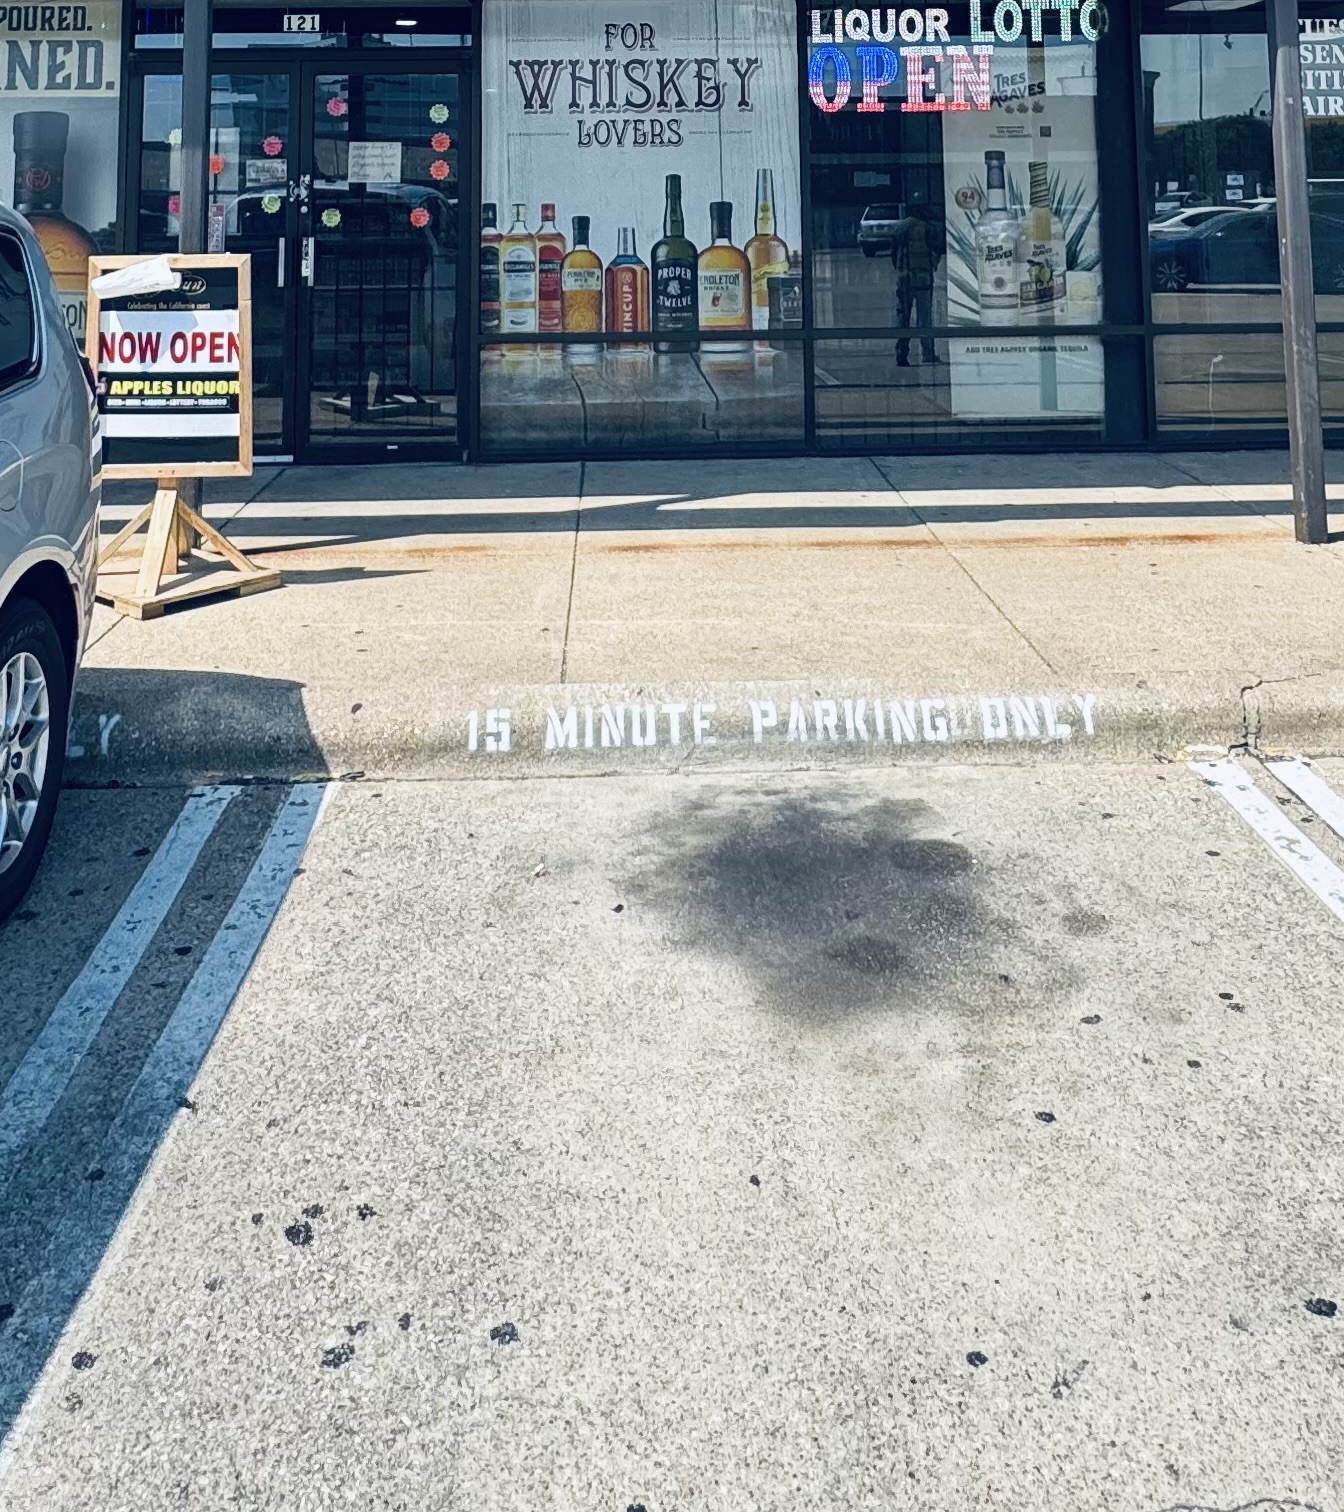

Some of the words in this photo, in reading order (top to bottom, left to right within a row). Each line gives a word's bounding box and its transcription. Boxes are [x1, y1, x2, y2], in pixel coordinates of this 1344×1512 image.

[285, 15, 319, 31] 121
[604, 23, 657, 53] FOR
[810, 8, 951, 44] LIQUOR
[509, 57, 763, 115] WHISKEY
[808, 44, 995, 113] OPEN
[994, 71, 1027, 88] TRES
[577, 118, 685, 148] LOVERS
[658, 266, 692, 281] PROPER
[658, 294, 693, 307] TWELVE
[99, 331, 162, 364] NOW
[169, 331, 240, 364] OPEN
[110, 380, 173, 395] APPLES
[176, 380, 240, 396] LIQUOR
[465, 708, 512, 752] 15
[545, 703, 718, 751] MINUTE
[751, 698, 950, 745] PARKING
